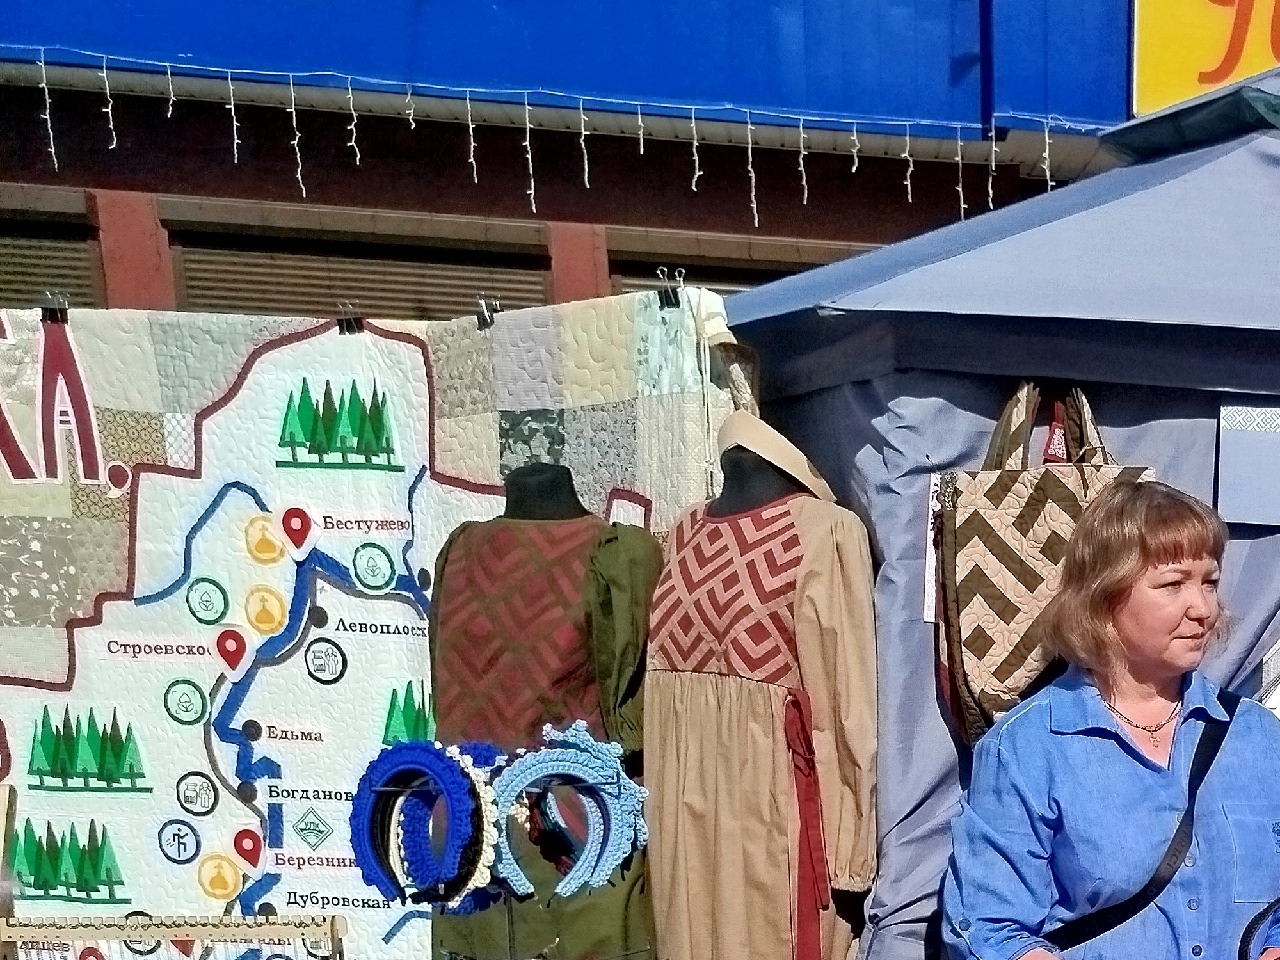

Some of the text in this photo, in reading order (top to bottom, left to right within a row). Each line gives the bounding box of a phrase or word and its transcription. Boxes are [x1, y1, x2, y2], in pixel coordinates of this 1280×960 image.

[322, 515, 411, 534] Бестужево
[107, 640, 212, 659] Строевско
[266, 725, 324, 743] Едьма
[286, 891, 391, 910] Дубровская
